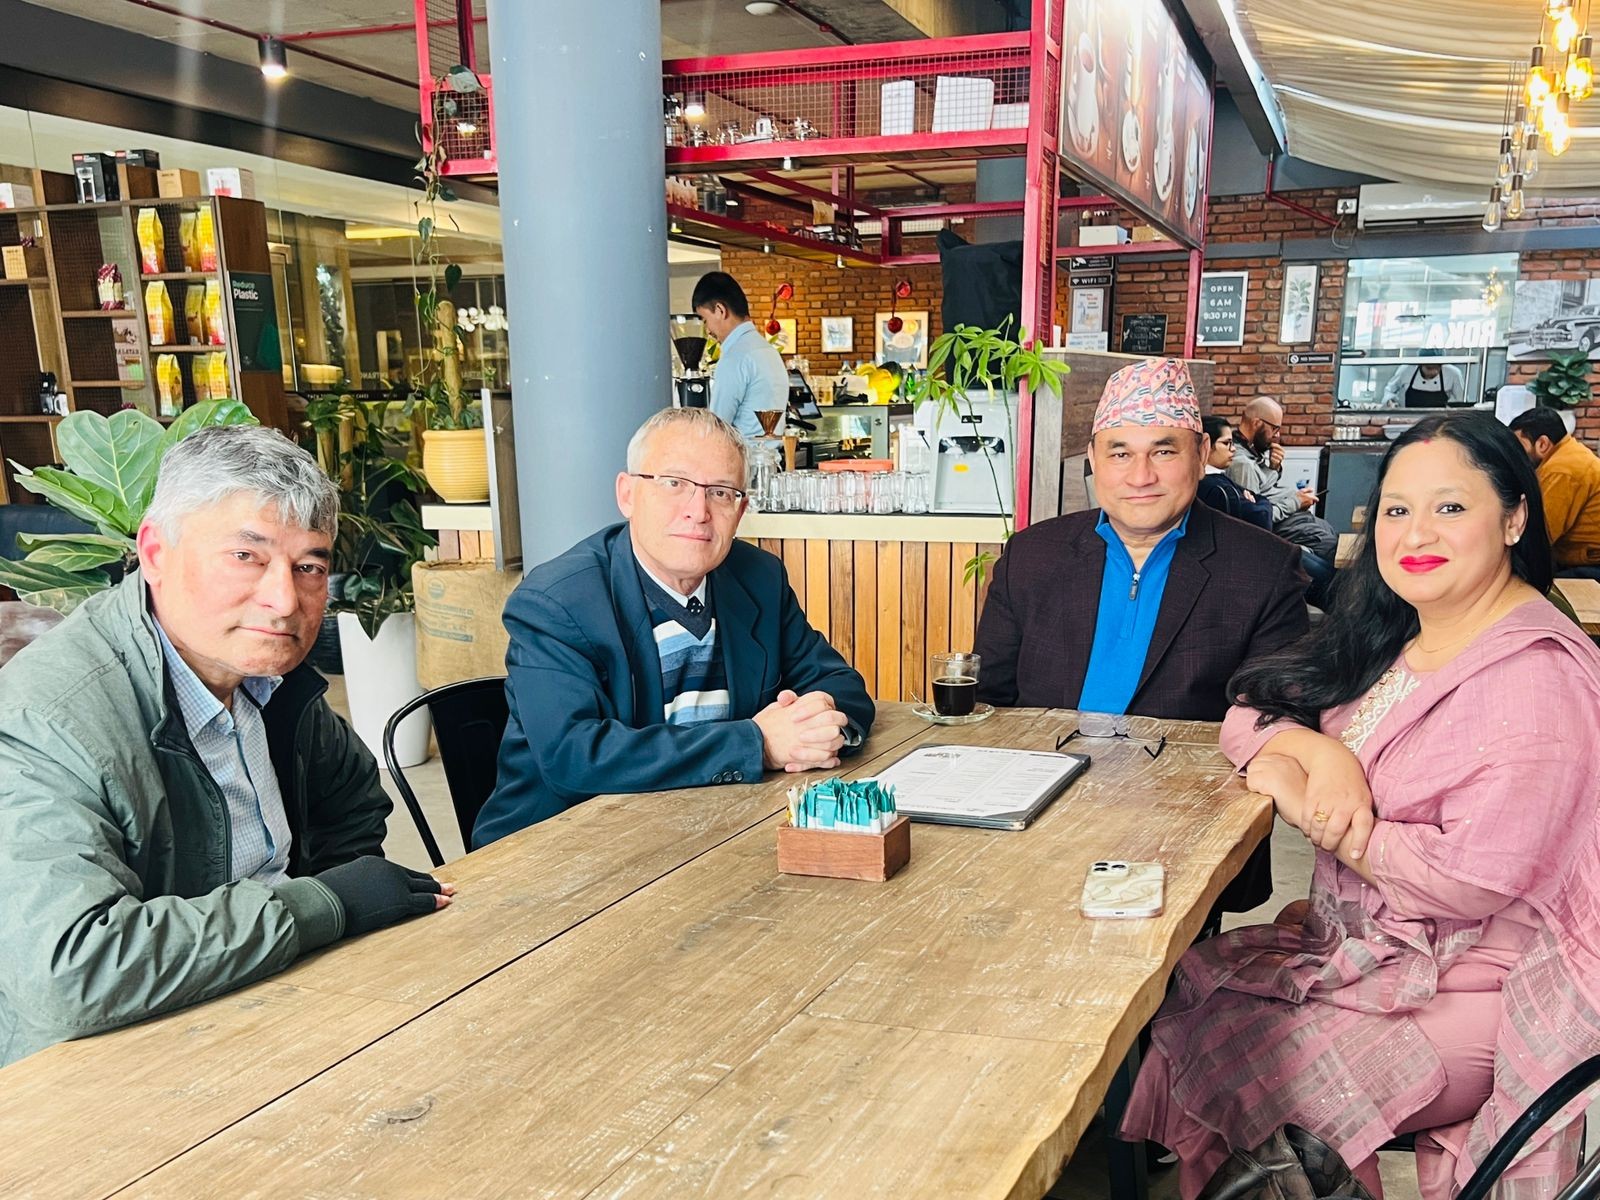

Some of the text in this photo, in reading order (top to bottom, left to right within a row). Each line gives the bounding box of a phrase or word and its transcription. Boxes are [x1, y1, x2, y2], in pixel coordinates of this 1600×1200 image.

[1210, 285, 1234, 293] OPEN
[233, 288, 259, 301] Plastic
[1221, 311, 1237, 320] PM
[1212, 325, 1233, 333] DAYS
